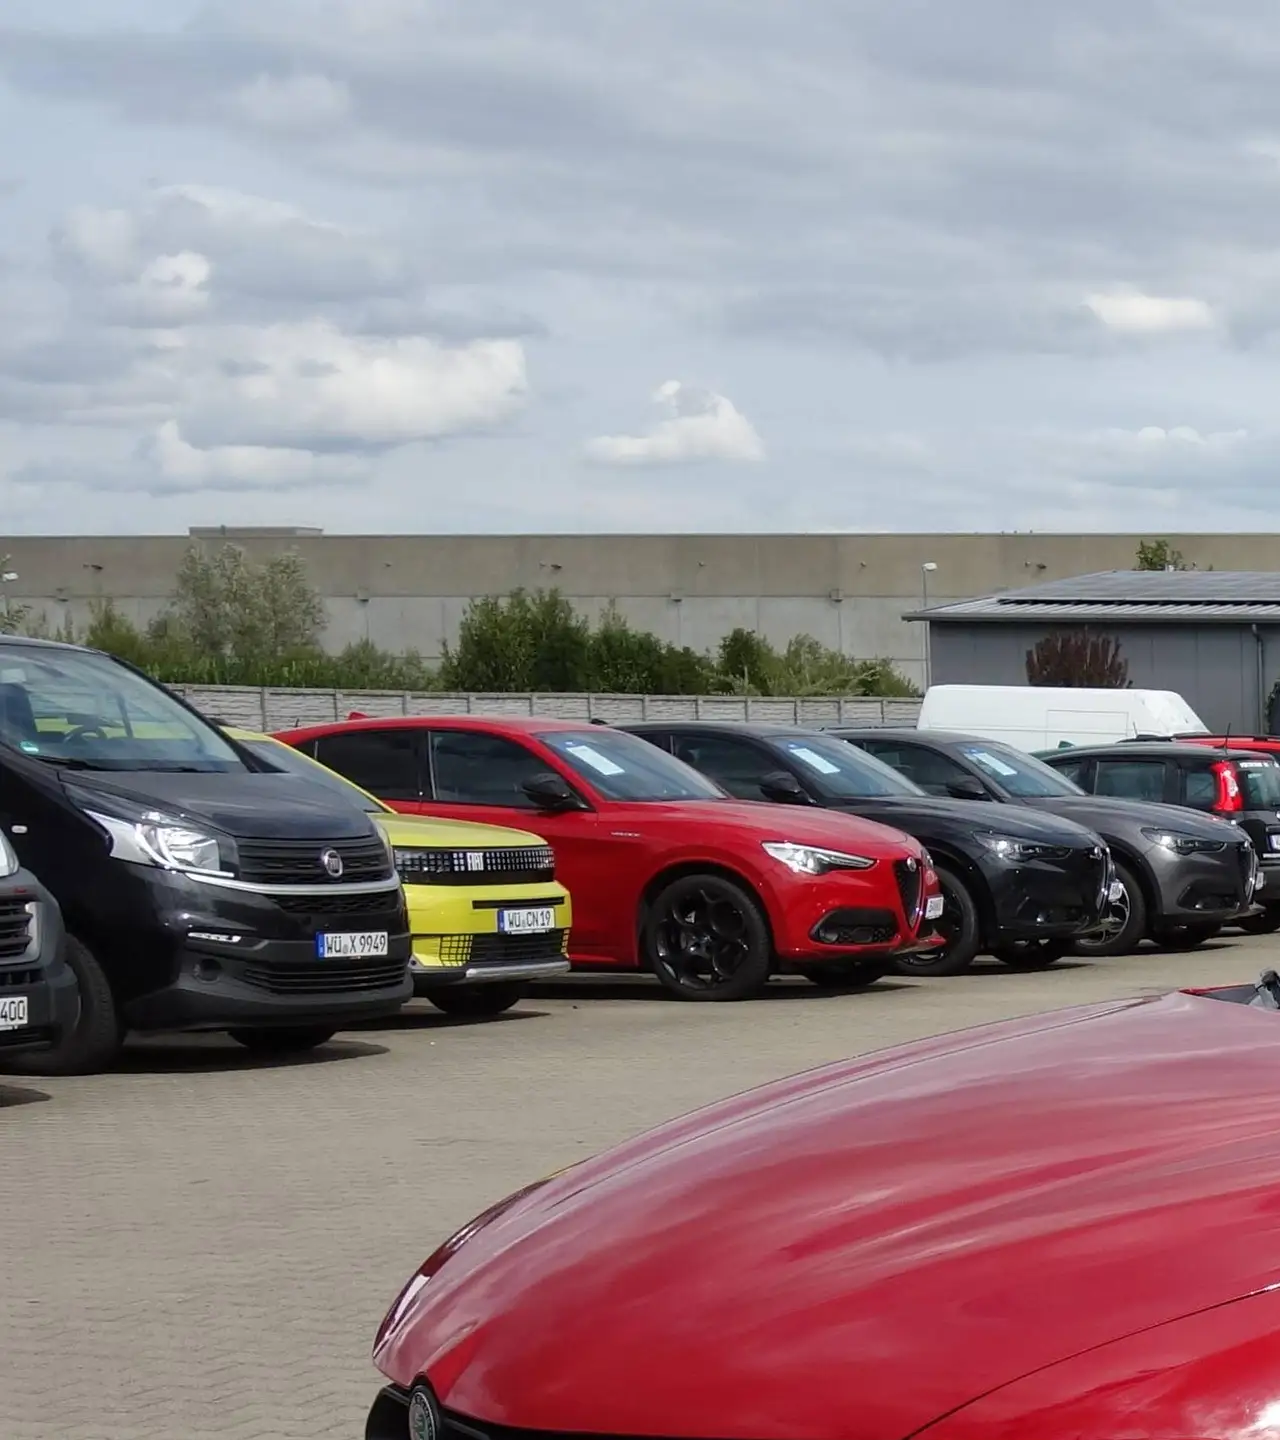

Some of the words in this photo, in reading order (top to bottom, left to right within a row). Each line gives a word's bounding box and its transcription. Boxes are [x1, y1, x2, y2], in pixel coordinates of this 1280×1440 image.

[466, 852, 484, 871] FIAT
[349, 935, 357, 953] X
[360, 934, 386, 953] 9949
